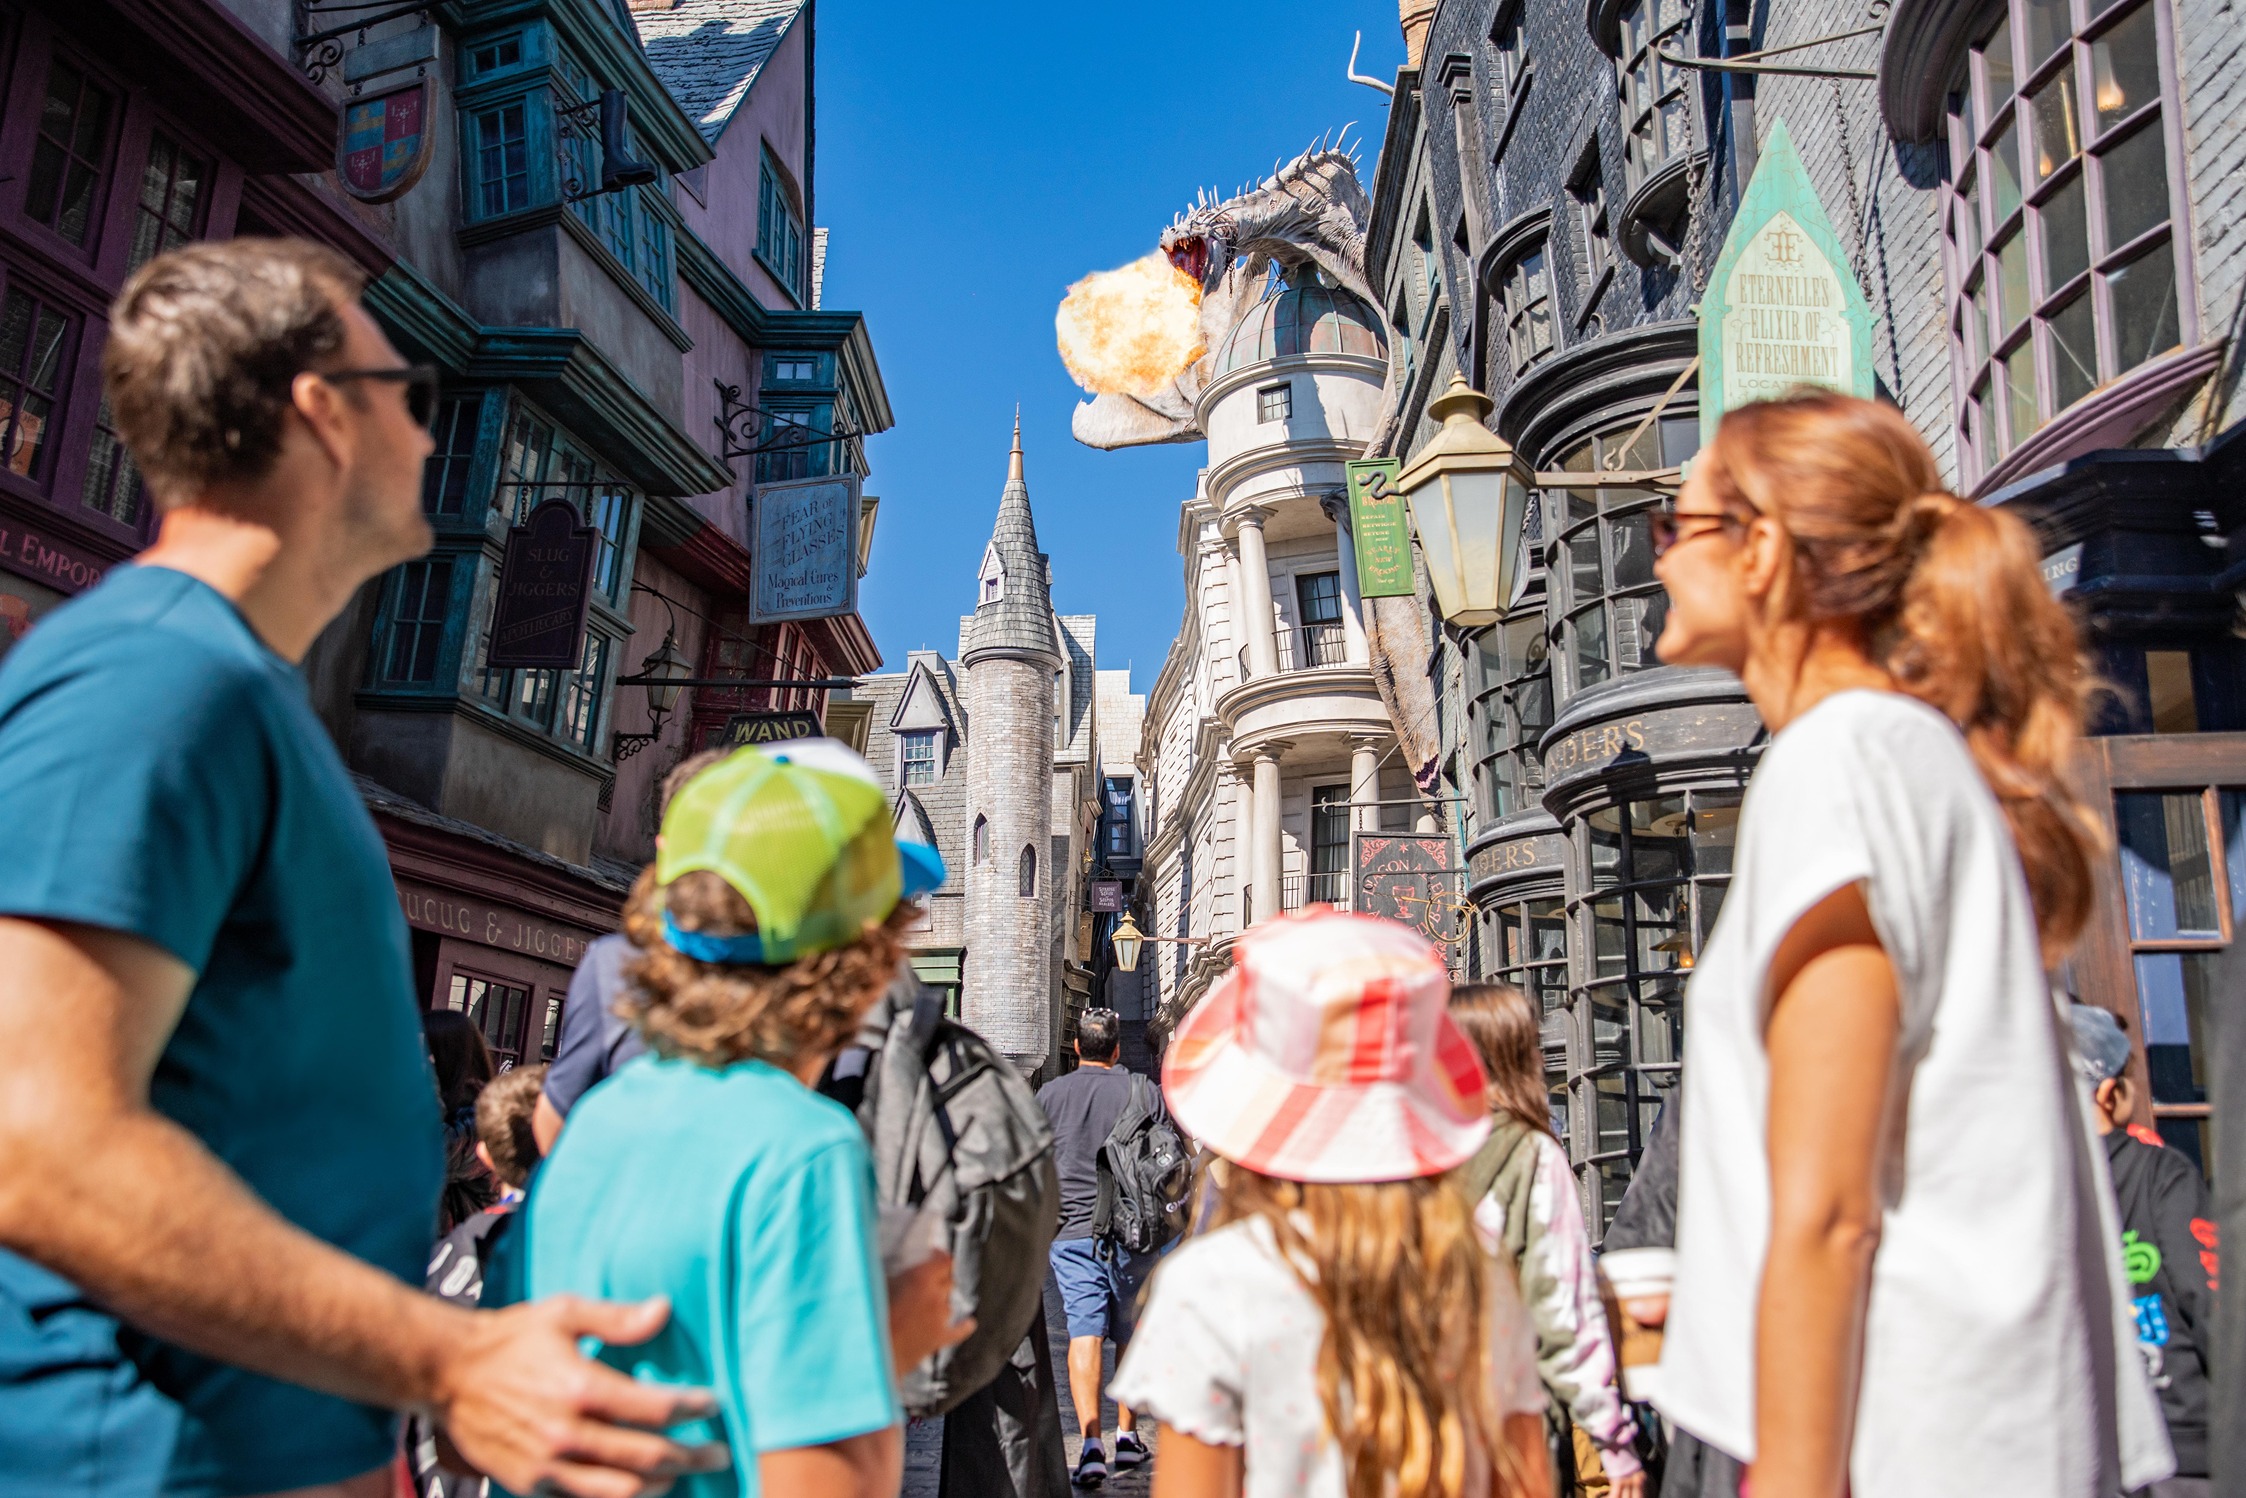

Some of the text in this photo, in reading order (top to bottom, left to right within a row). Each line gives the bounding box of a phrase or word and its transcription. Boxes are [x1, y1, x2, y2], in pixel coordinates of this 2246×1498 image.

[1739, 274, 1829, 307] ETERNELLE'S
[1751, 309, 1821, 342] ELIXIR OF
[1736, 343, 1839, 377] REFRESHMENT
[782, 500, 819, 530] FEAR
[782, 512, 834, 550] FLYING
[528, 548, 570, 562] SLUG
[540, 564, 553, 579] &
[768, 567, 839, 592] Magical Cures
[507, 582, 578, 597] JIGGERS
[776, 590, 832, 609] Preventions
[500, 609, 574, 642] APOTHECARY
[734, 720, 811, 742] WAND
[486, 912, 503, 944] &
